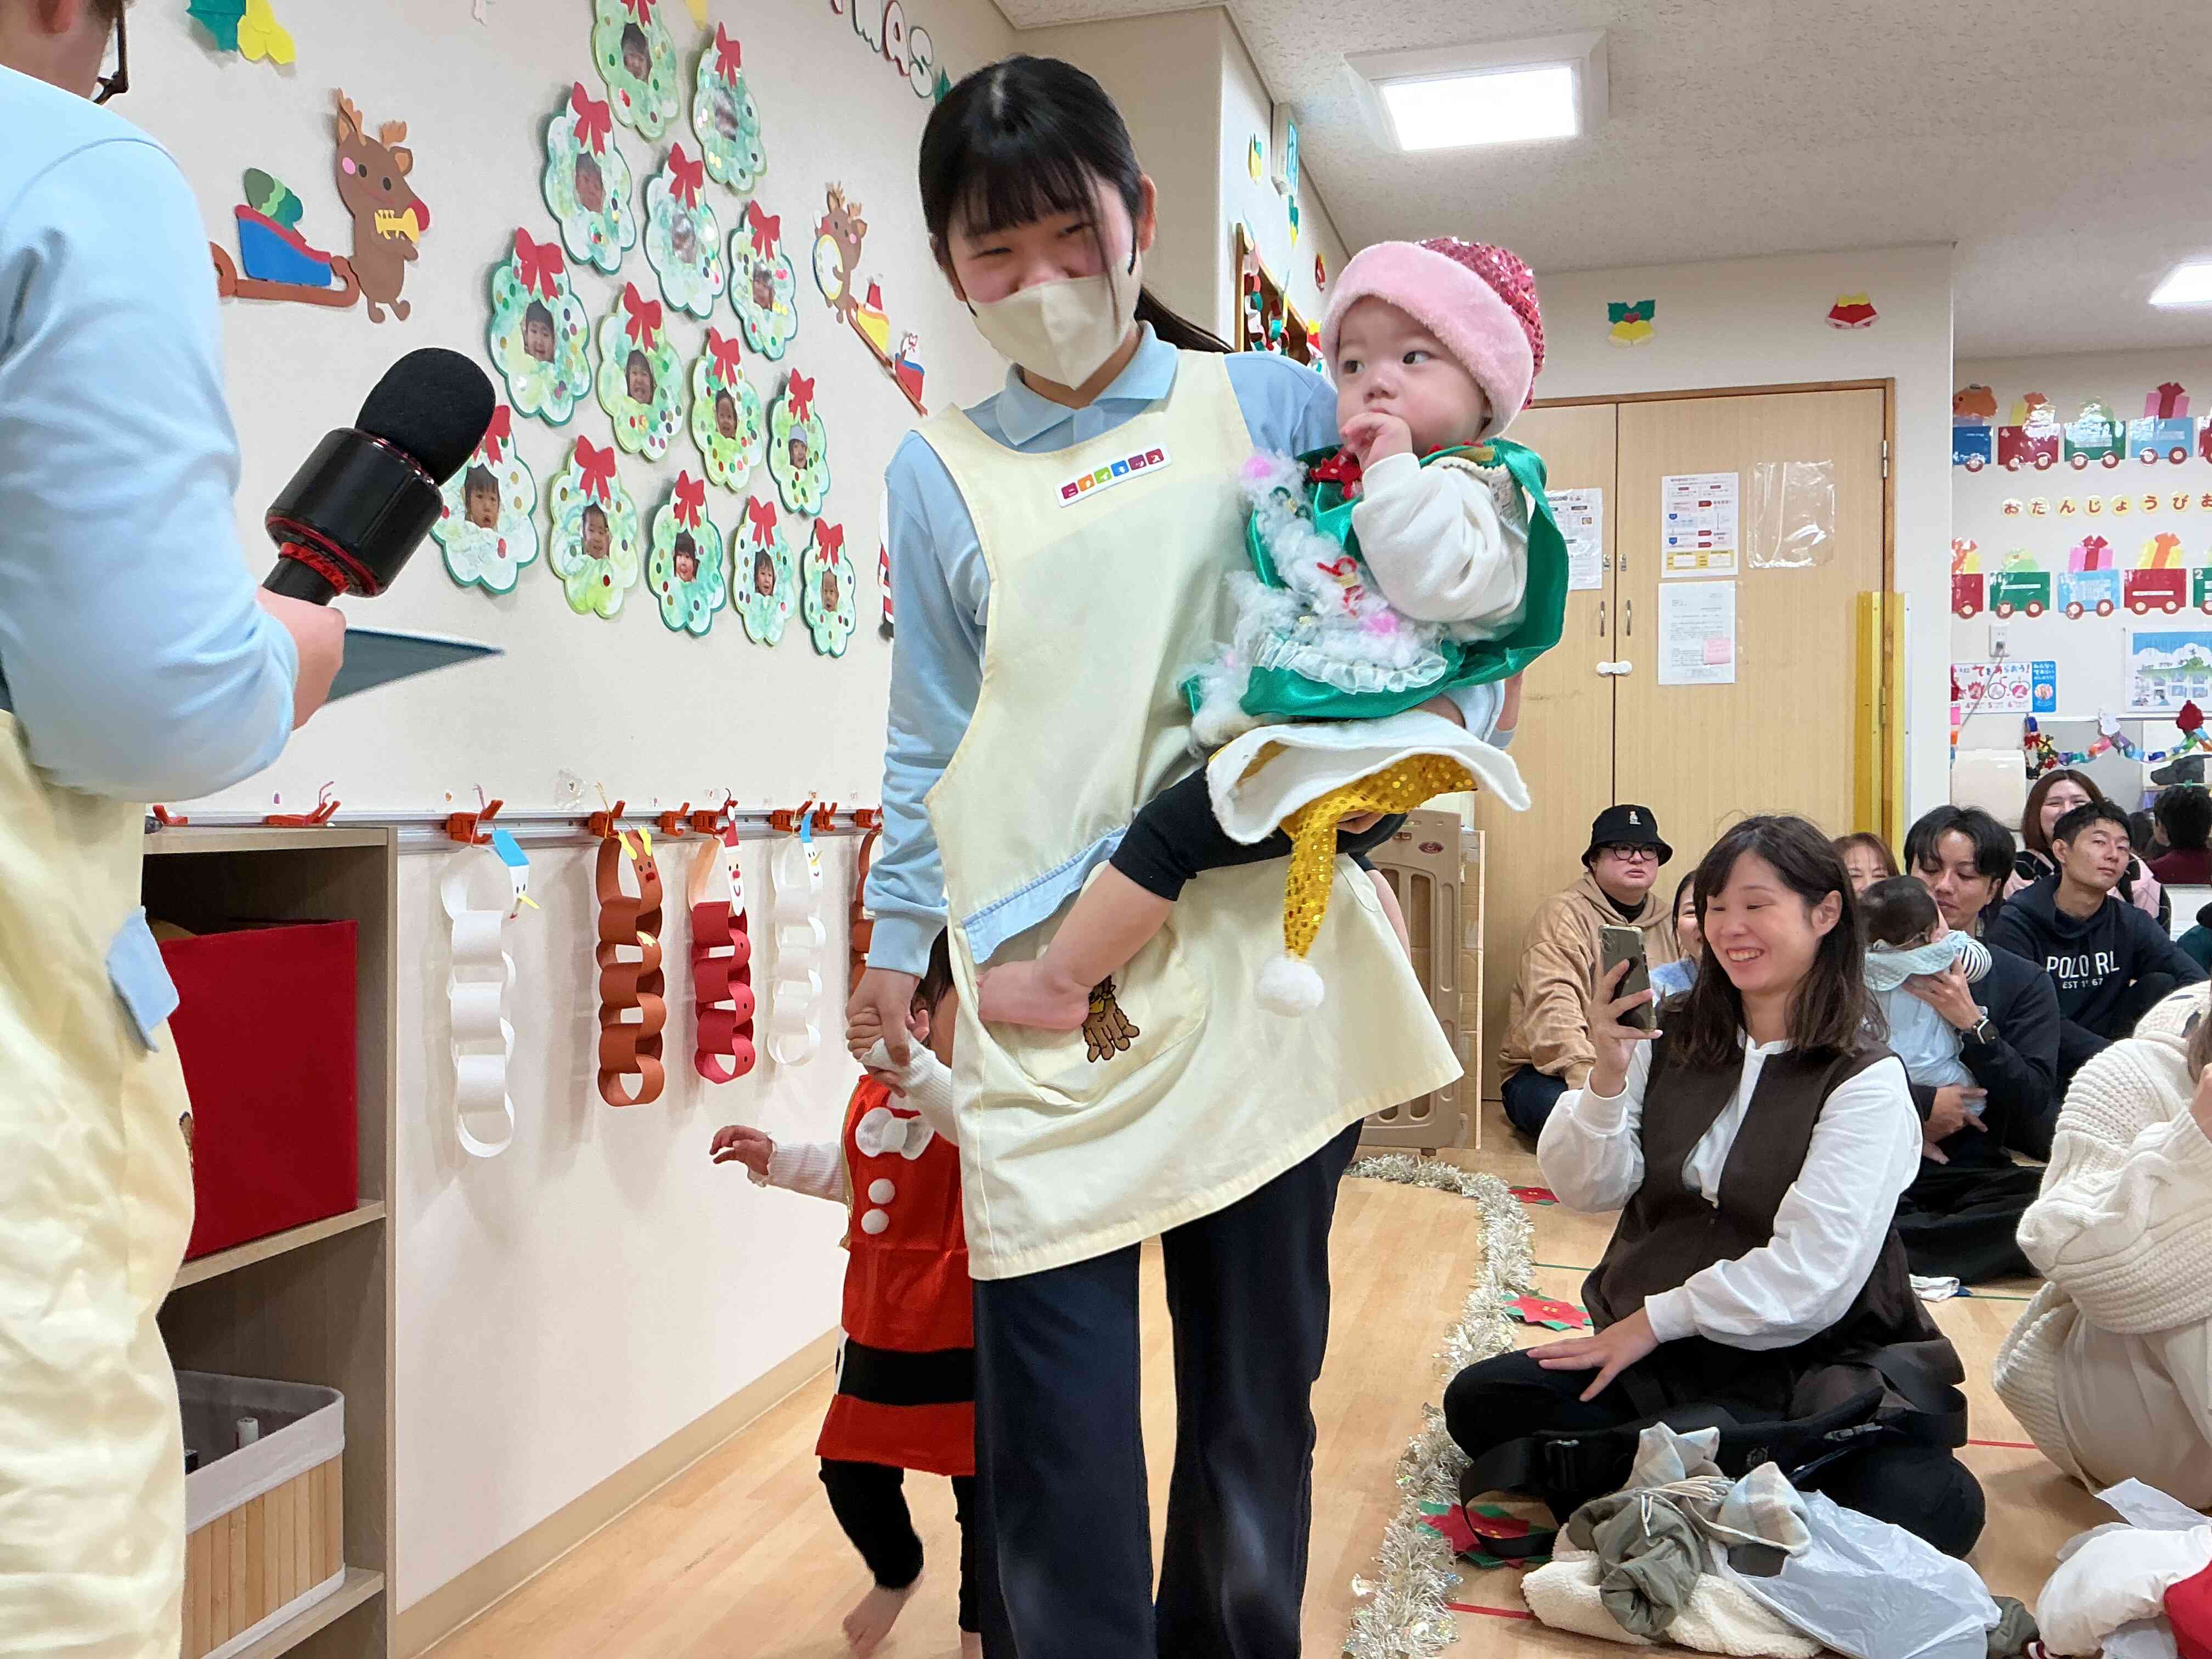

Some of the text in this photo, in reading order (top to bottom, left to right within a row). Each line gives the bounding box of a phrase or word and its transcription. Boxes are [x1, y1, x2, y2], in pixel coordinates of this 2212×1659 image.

[2194, 569, 2203, 579] 2
[2046, 950, 2120, 979] POLO RL
